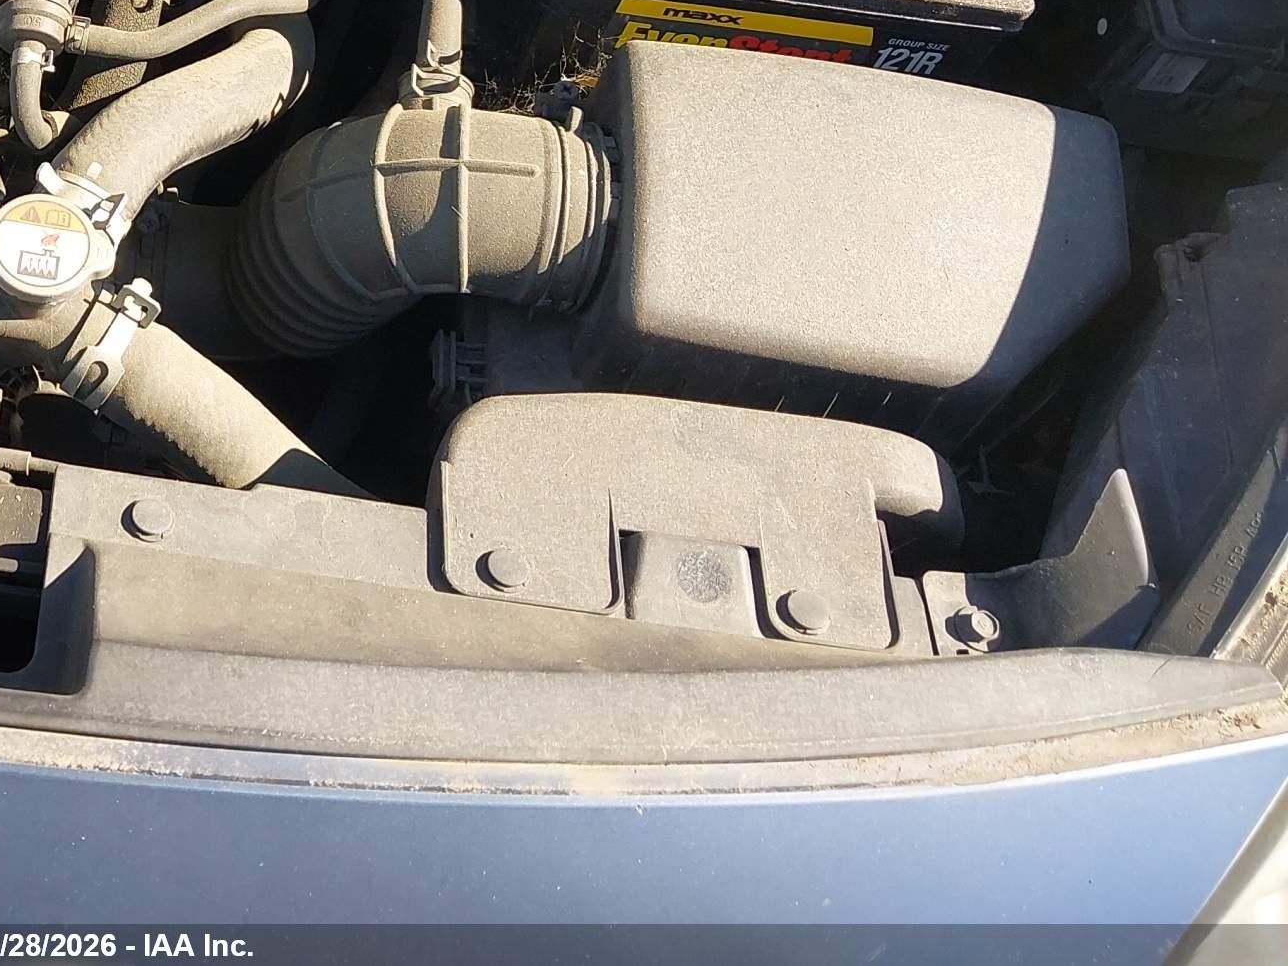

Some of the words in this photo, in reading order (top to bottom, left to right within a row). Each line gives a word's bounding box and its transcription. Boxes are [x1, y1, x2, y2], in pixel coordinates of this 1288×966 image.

[662, 7, 745, 26] maxx
[887, 38, 926, 49] GROUP
[926, 42, 952, 52] SIZE
[872, 47, 944, 75] 121R
